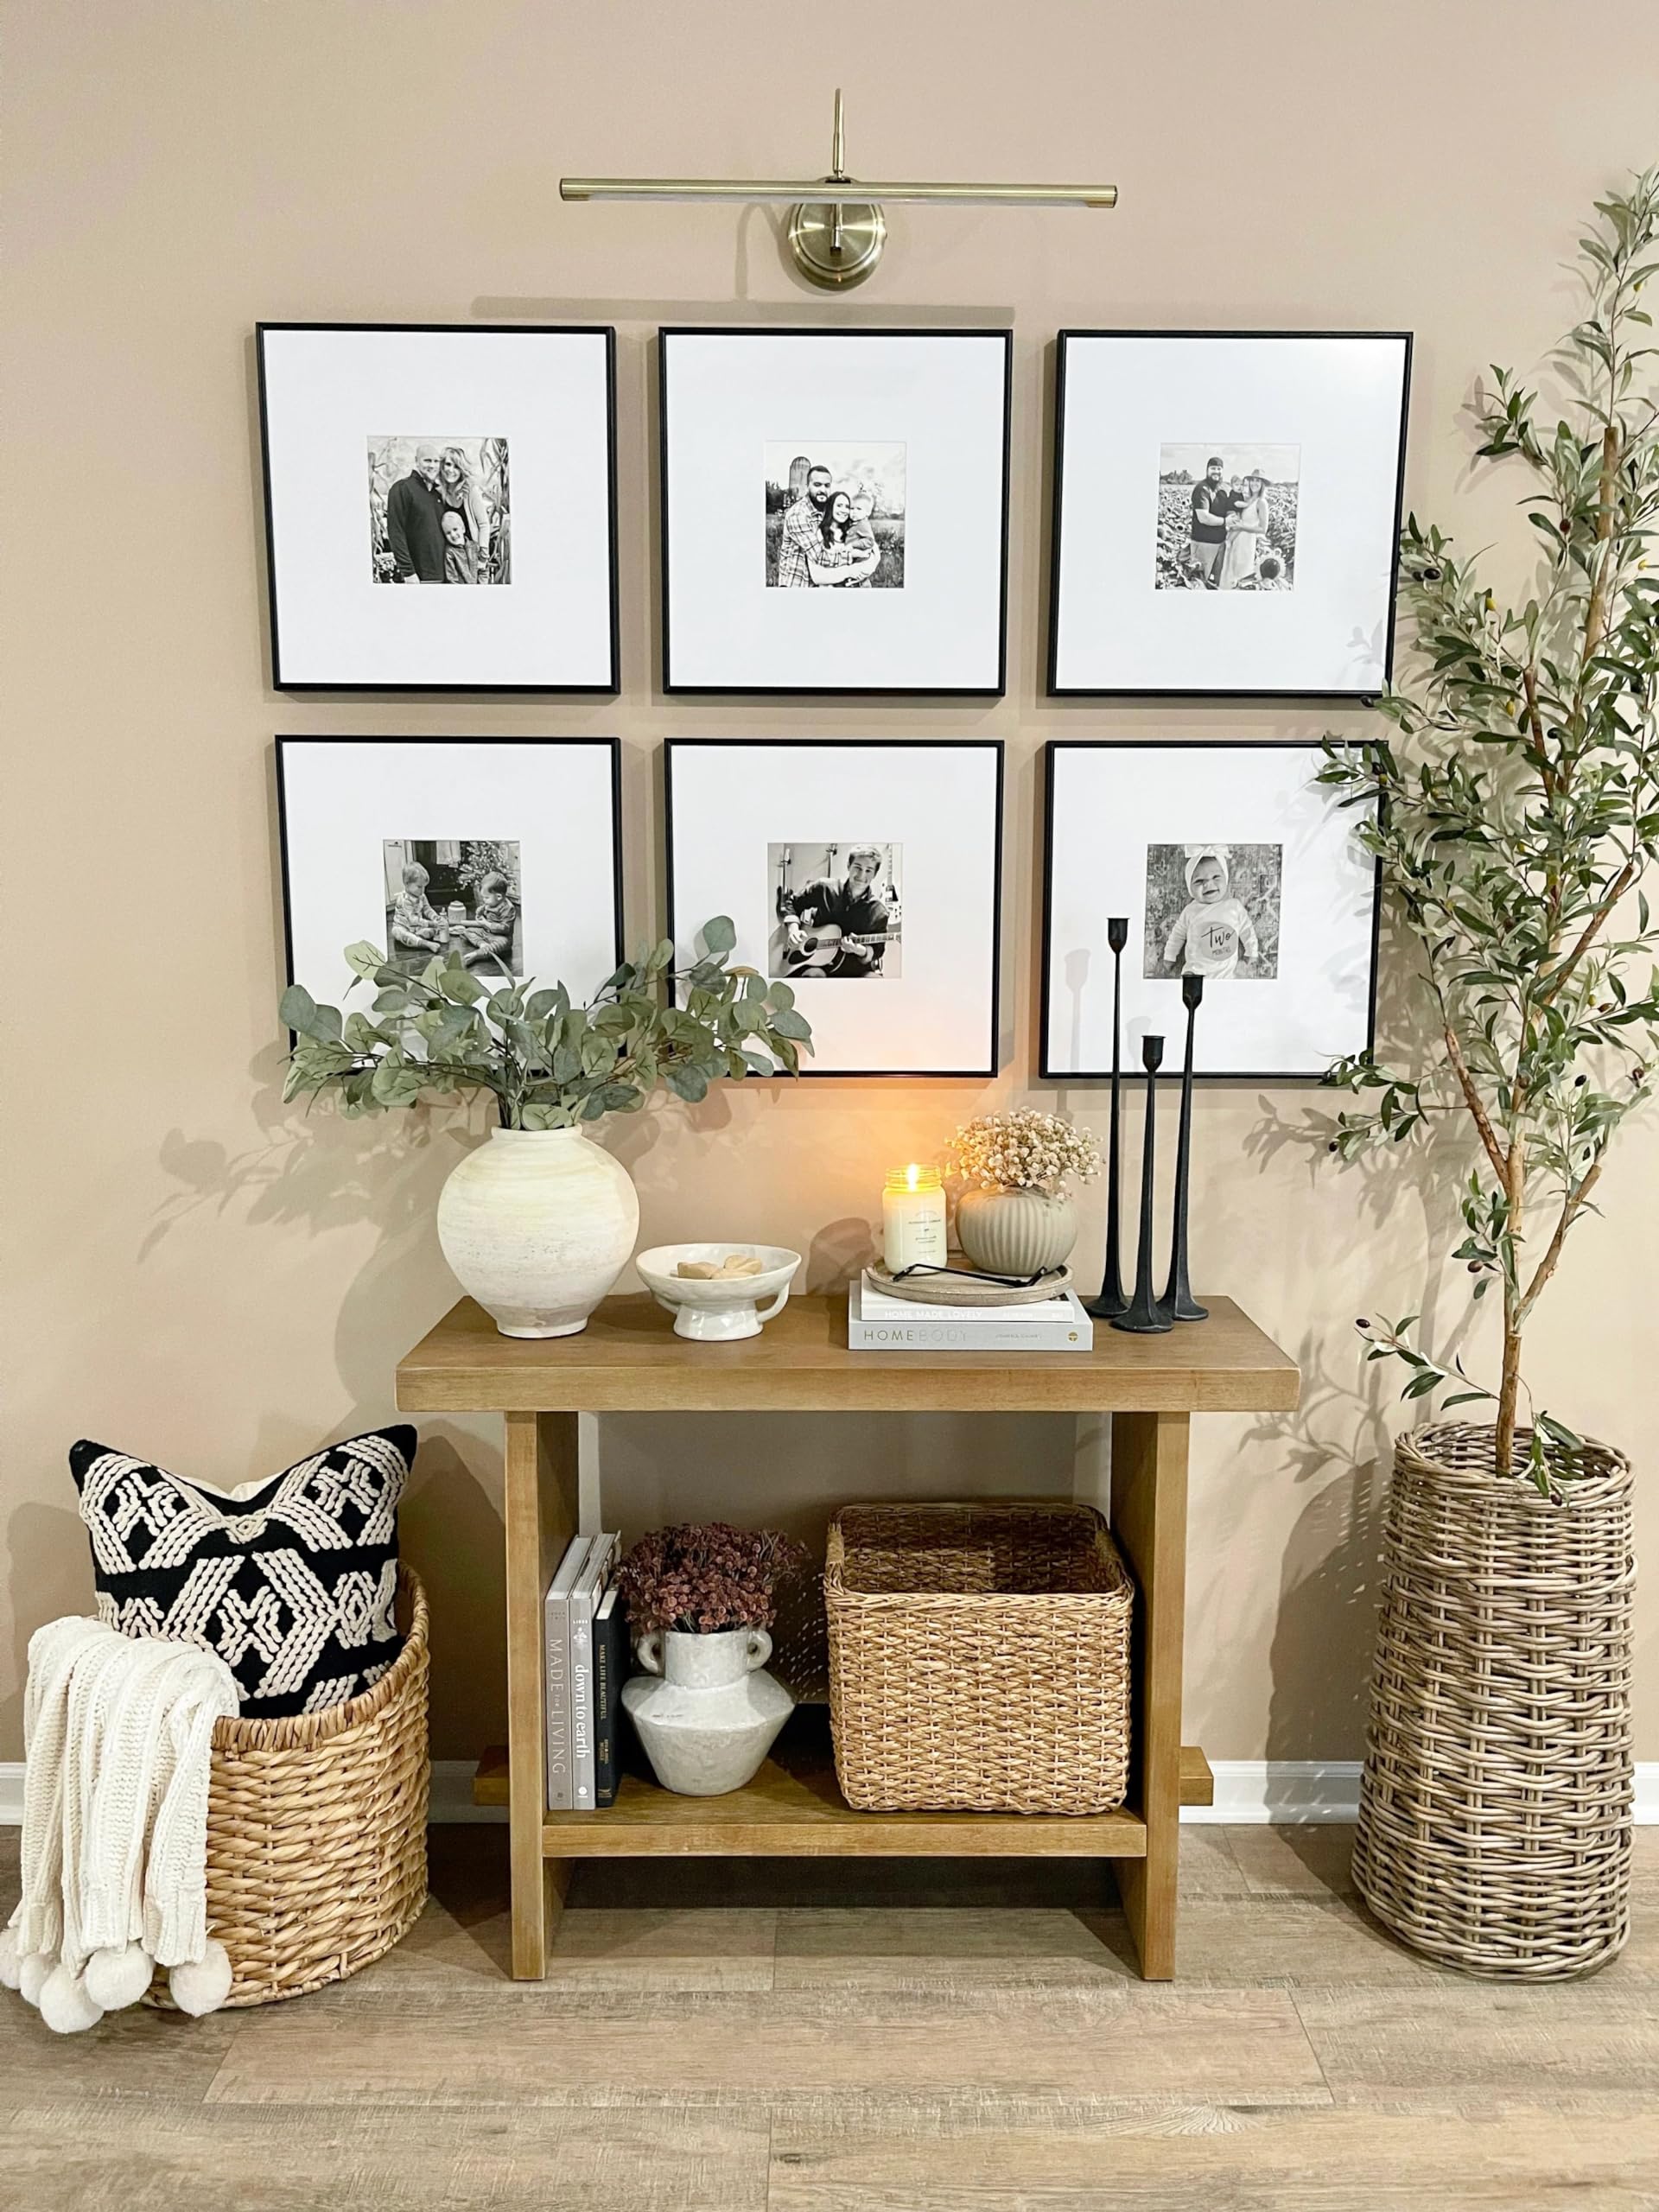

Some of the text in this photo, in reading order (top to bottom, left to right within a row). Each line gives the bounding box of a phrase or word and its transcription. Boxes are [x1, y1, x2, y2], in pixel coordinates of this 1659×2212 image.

[884, 1309, 982, 1319] HOME MADE LOVELY
[549, 1639, 564, 1692] MADE
[575, 1664, 591, 1758] down to earth
[551, 1711, 566, 1773] LIVING
